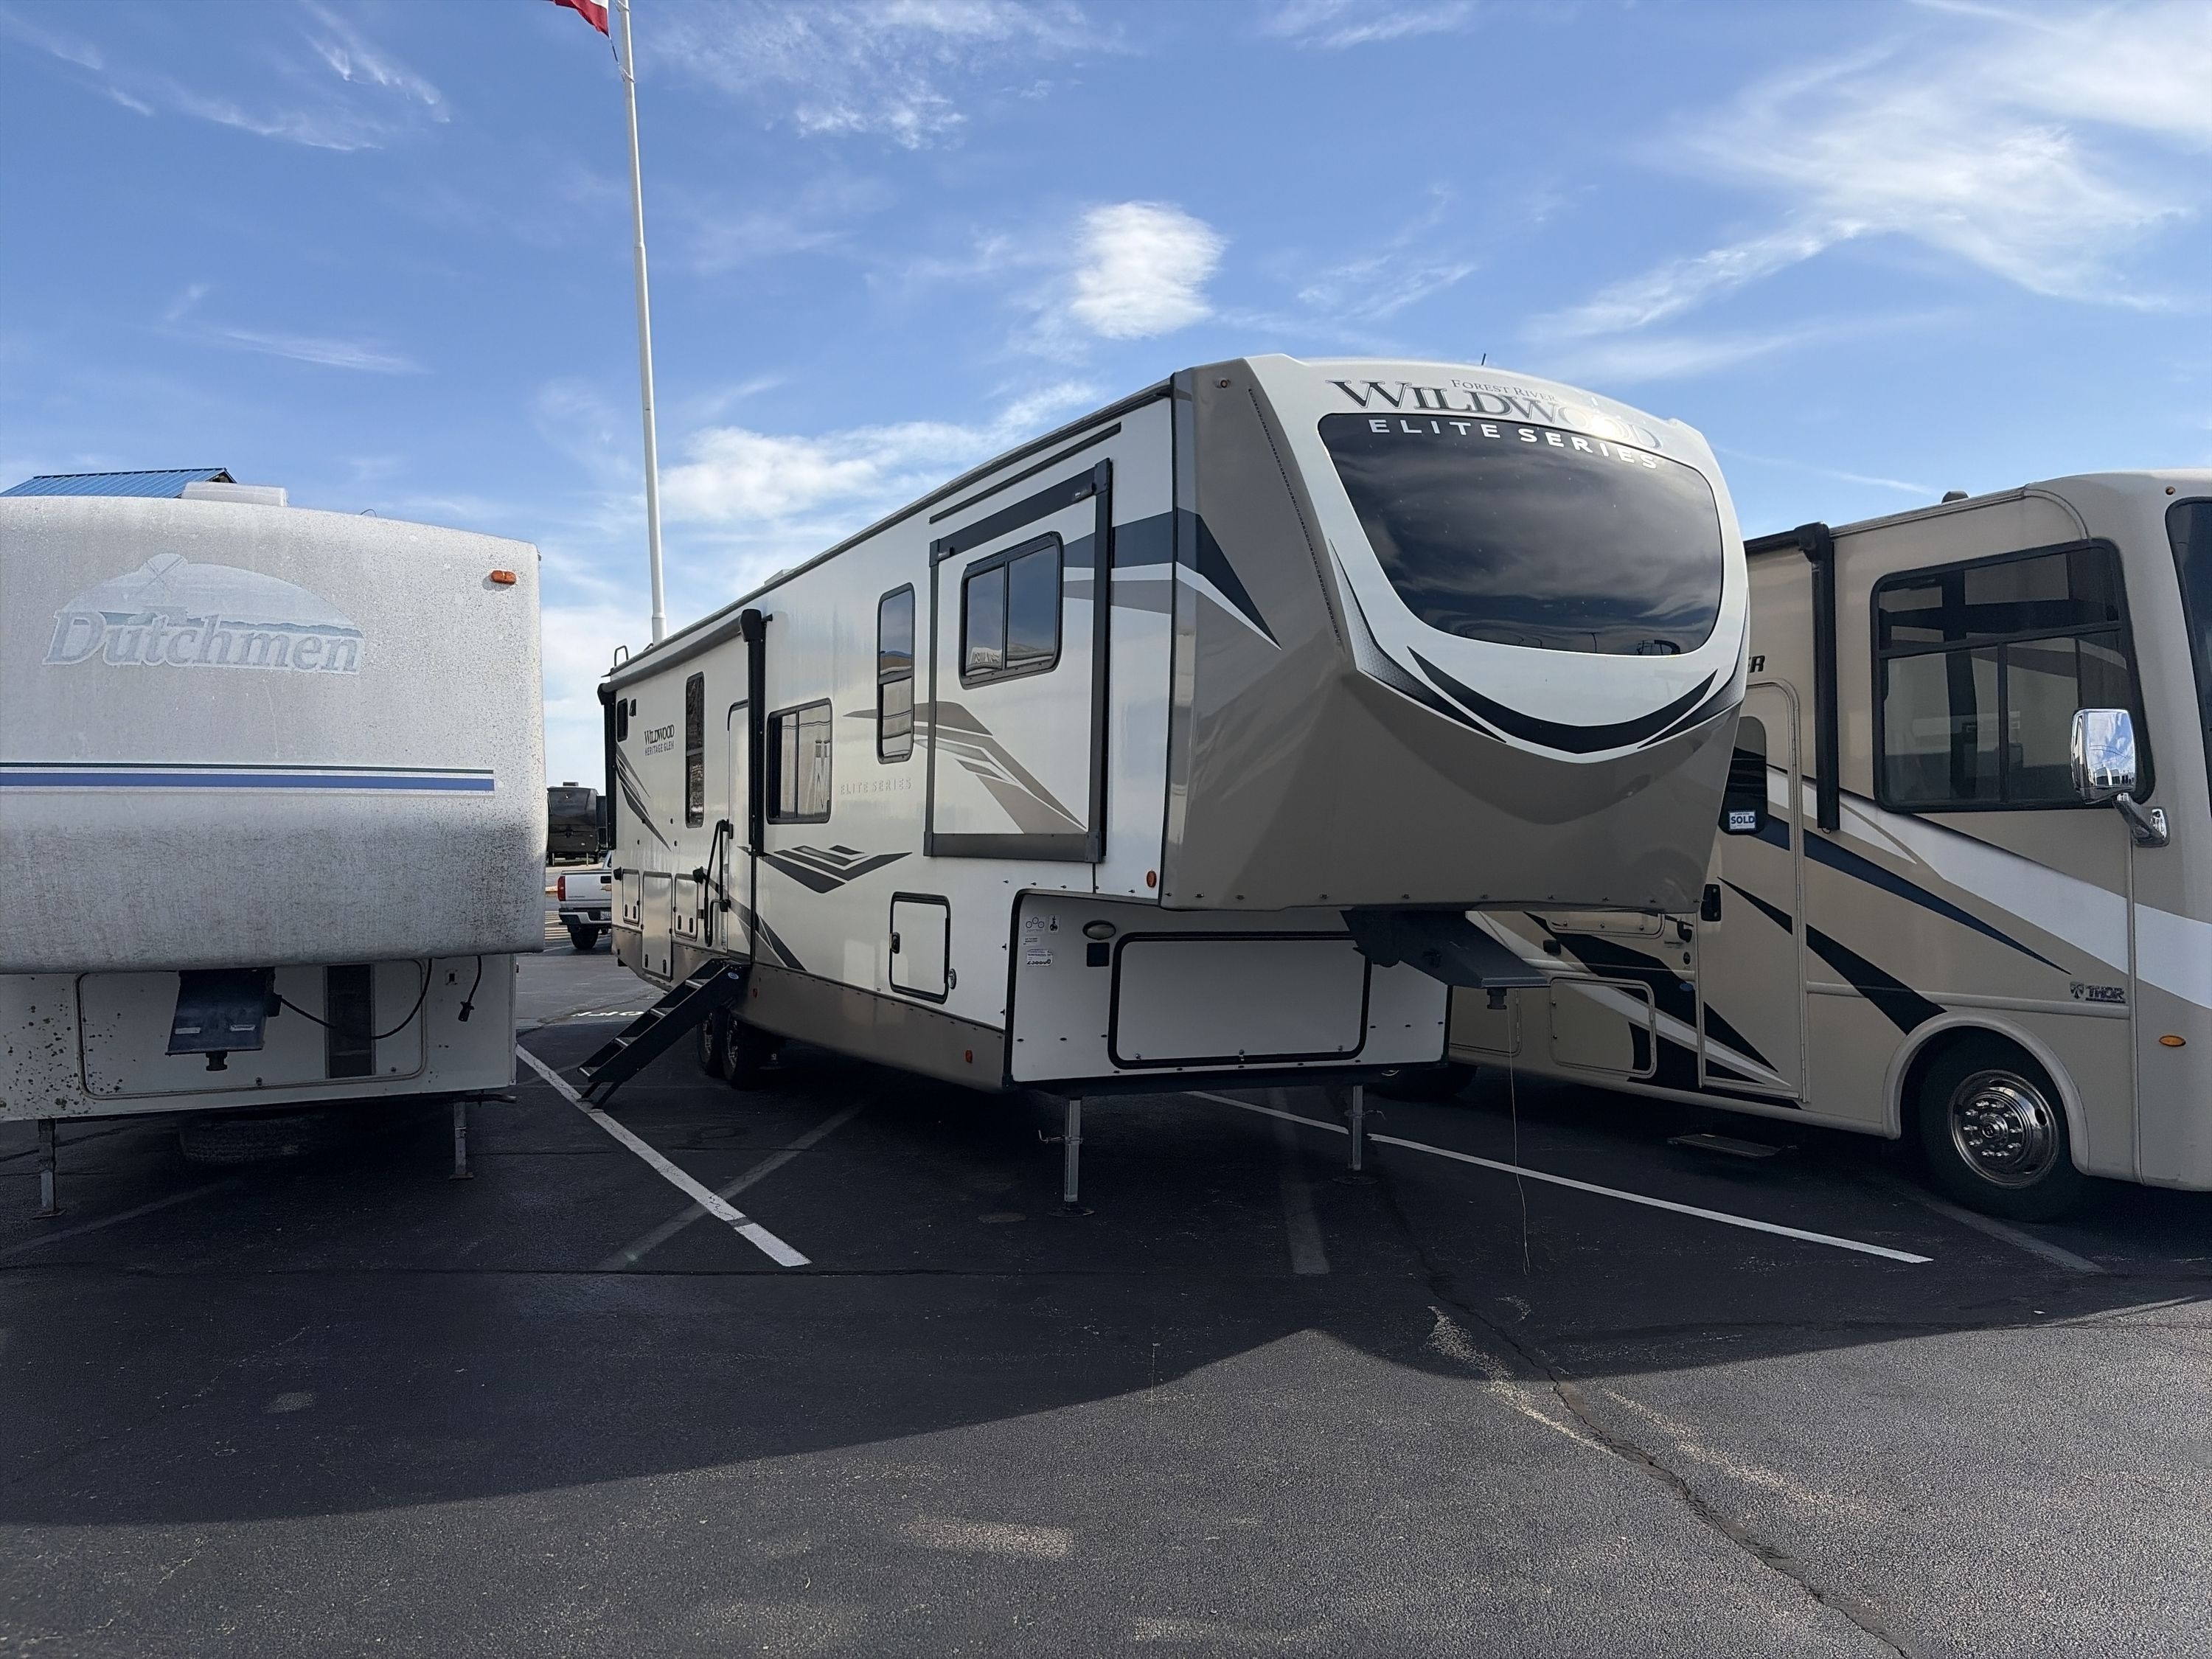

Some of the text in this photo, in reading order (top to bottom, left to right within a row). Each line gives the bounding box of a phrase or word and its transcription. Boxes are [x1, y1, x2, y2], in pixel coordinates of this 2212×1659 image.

[1451, 379, 1557, 402] FOREST RIVER
[1325, 380, 1663, 449] WILDWOOD
[1368, 419, 1657, 469] ELITE SERIES
[43, 611, 361, 674] Dutchmen
[644, 724, 675, 745] WILDWOOD
[664, 740, 675, 752] GLEN
[841, 778, 911, 795] ELITE SERIES
[1731, 815, 1755, 824] SOLD
[2085, 984, 2125, 1000] THOR
